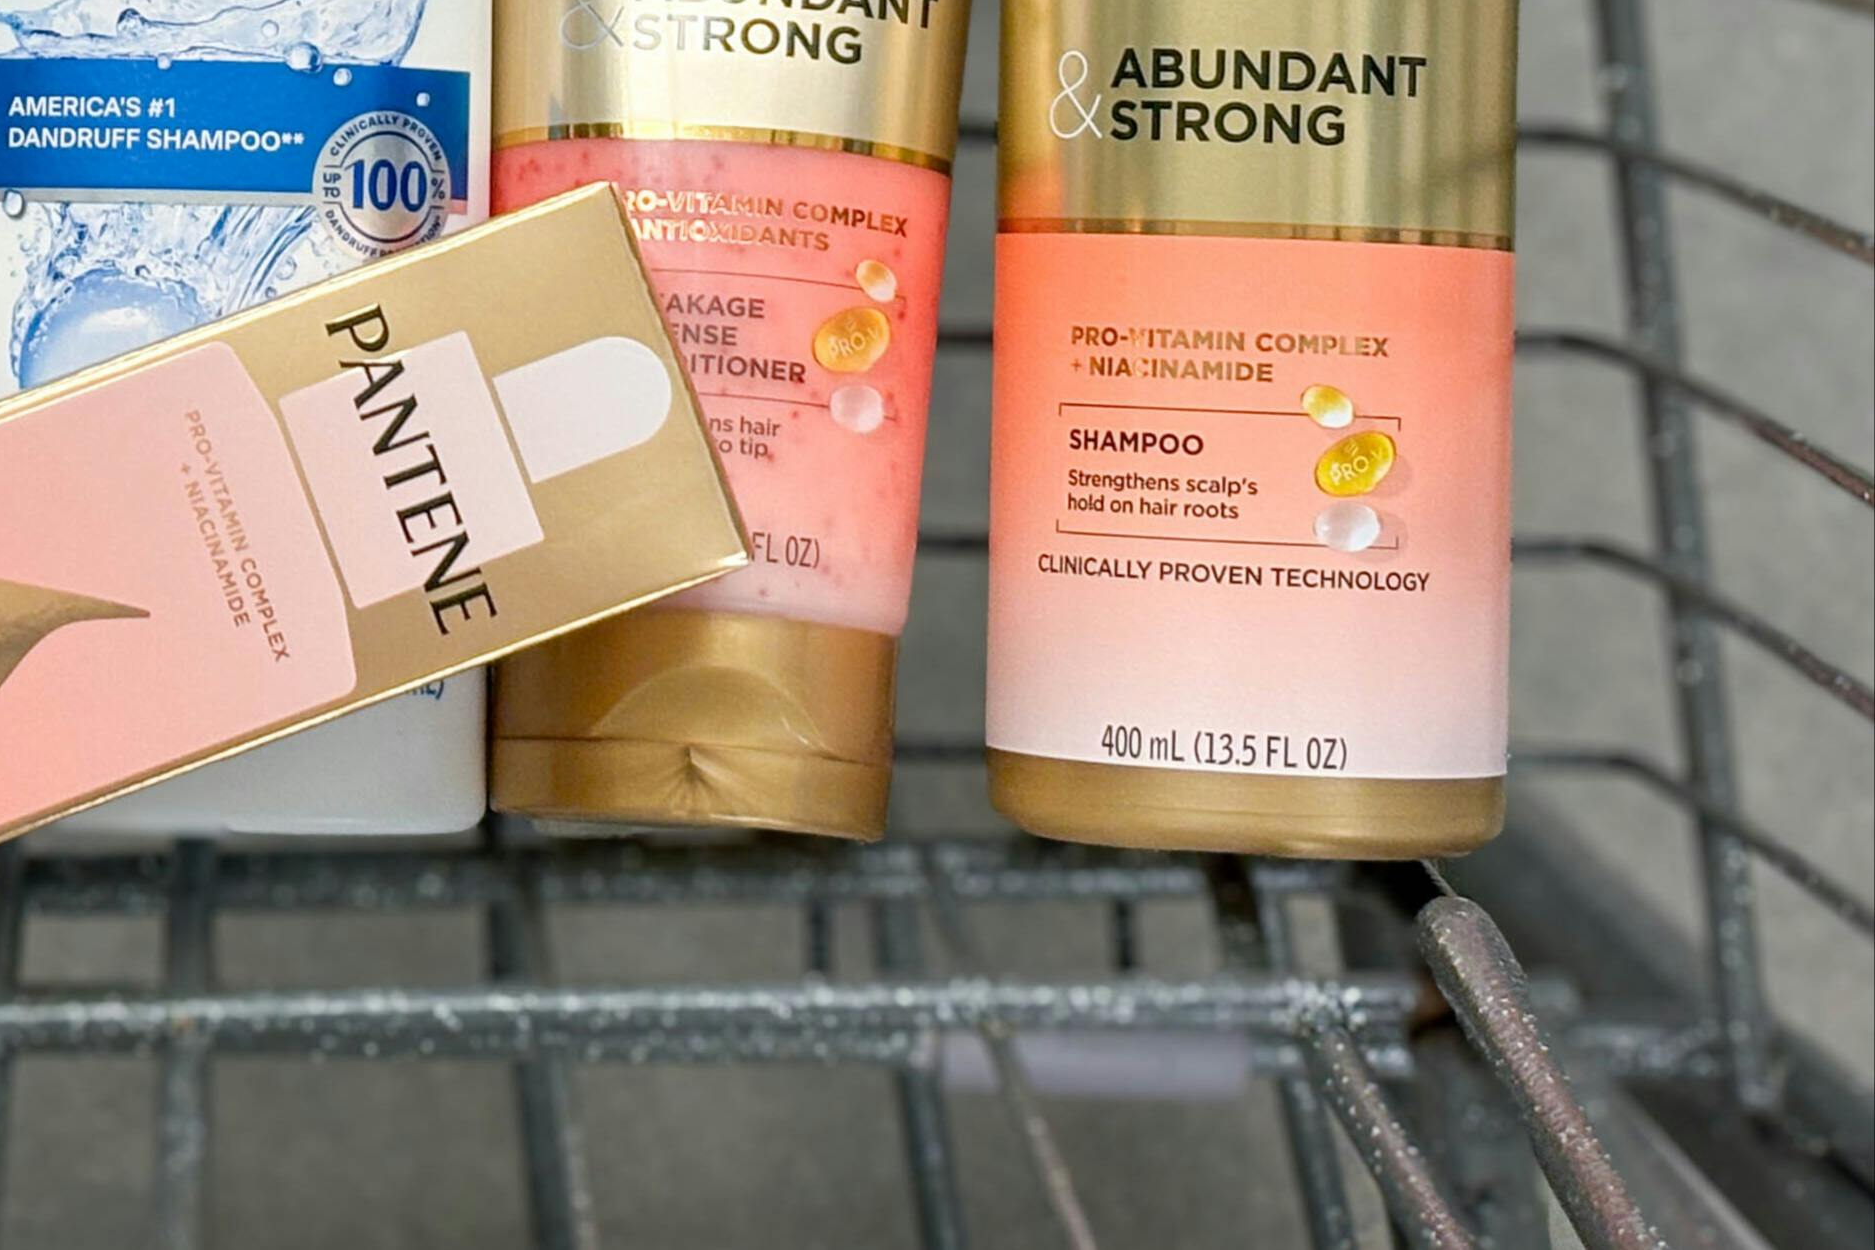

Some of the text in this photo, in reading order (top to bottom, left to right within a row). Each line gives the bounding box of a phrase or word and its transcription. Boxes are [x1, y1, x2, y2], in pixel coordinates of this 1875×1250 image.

[632, 12, 862, 65] STRONG
[1110, 47, 1427, 98] ABUNDANT
[8, 96, 175, 118] AMERICA'S #1
[1049, 50, 1346, 146] & STRONG
[8, 127, 140, 149] DANDRUFF
[330, 114, 442, 161] CLINICALLY PROVEN
[323, 173, 341, 184] UP
[323, 187, 341, 198] TO
[792, 201, 908, 238] COMPLEX
[1071, 326, 1390, 358] PRO-VITAMIN COMPLEX
[1089, 356, 1274, 383] NIACINAMIDE
[739, 415, 782, 437] hair
[1069, 429, 1204, 456] SHAMPOO
[325, 303, 498, 636] PANTENE
[1067, 469, 1258, 498] Strengthens scalp's
[1067, 495, 1240, 520] hold on hair roots
[186, 410, 290, 662] PRO-VITAMIN COMPLEX
[786, 535, 820, 569] OZ)
[186, 480, 250, 628] NIACINAMIDE
[1038, 553, 1430, 593] CLINICALLY PROVEN TECHNOLOGY
[1101, 724, 1348, 772] 400 mL (13.5 FL OZ)
